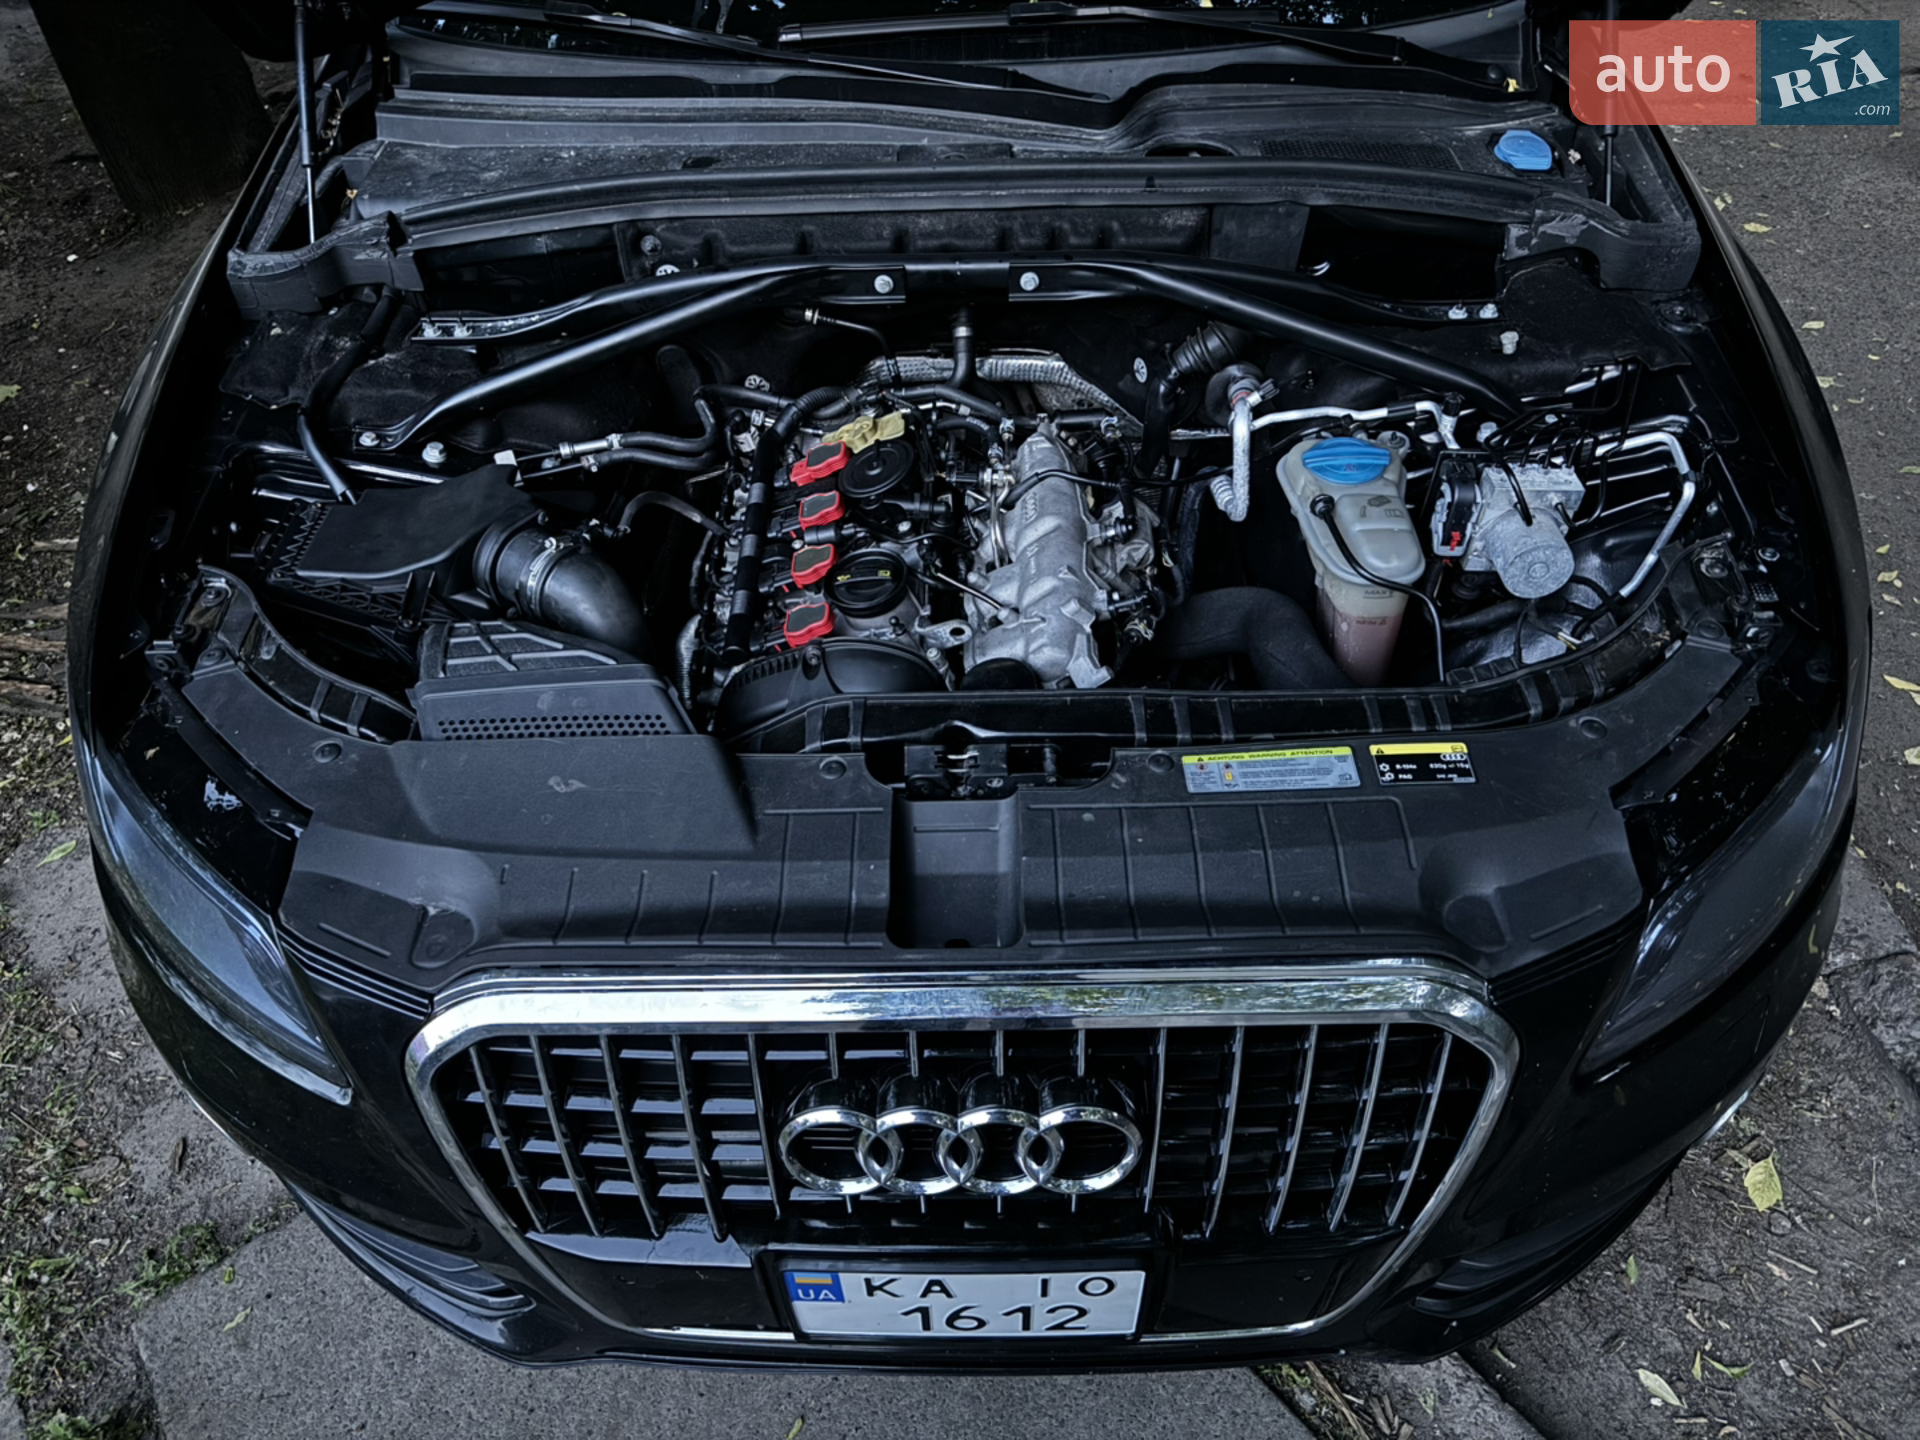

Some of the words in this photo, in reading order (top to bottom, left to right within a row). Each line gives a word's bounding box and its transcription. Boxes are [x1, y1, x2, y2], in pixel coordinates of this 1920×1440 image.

[1249, 751, 1286, 759] WARNING
[796, 1288, 837, 1301] UA
[863, 1276, 956, 1299] KA
[900, 1304, 1090, 1332] 1612
